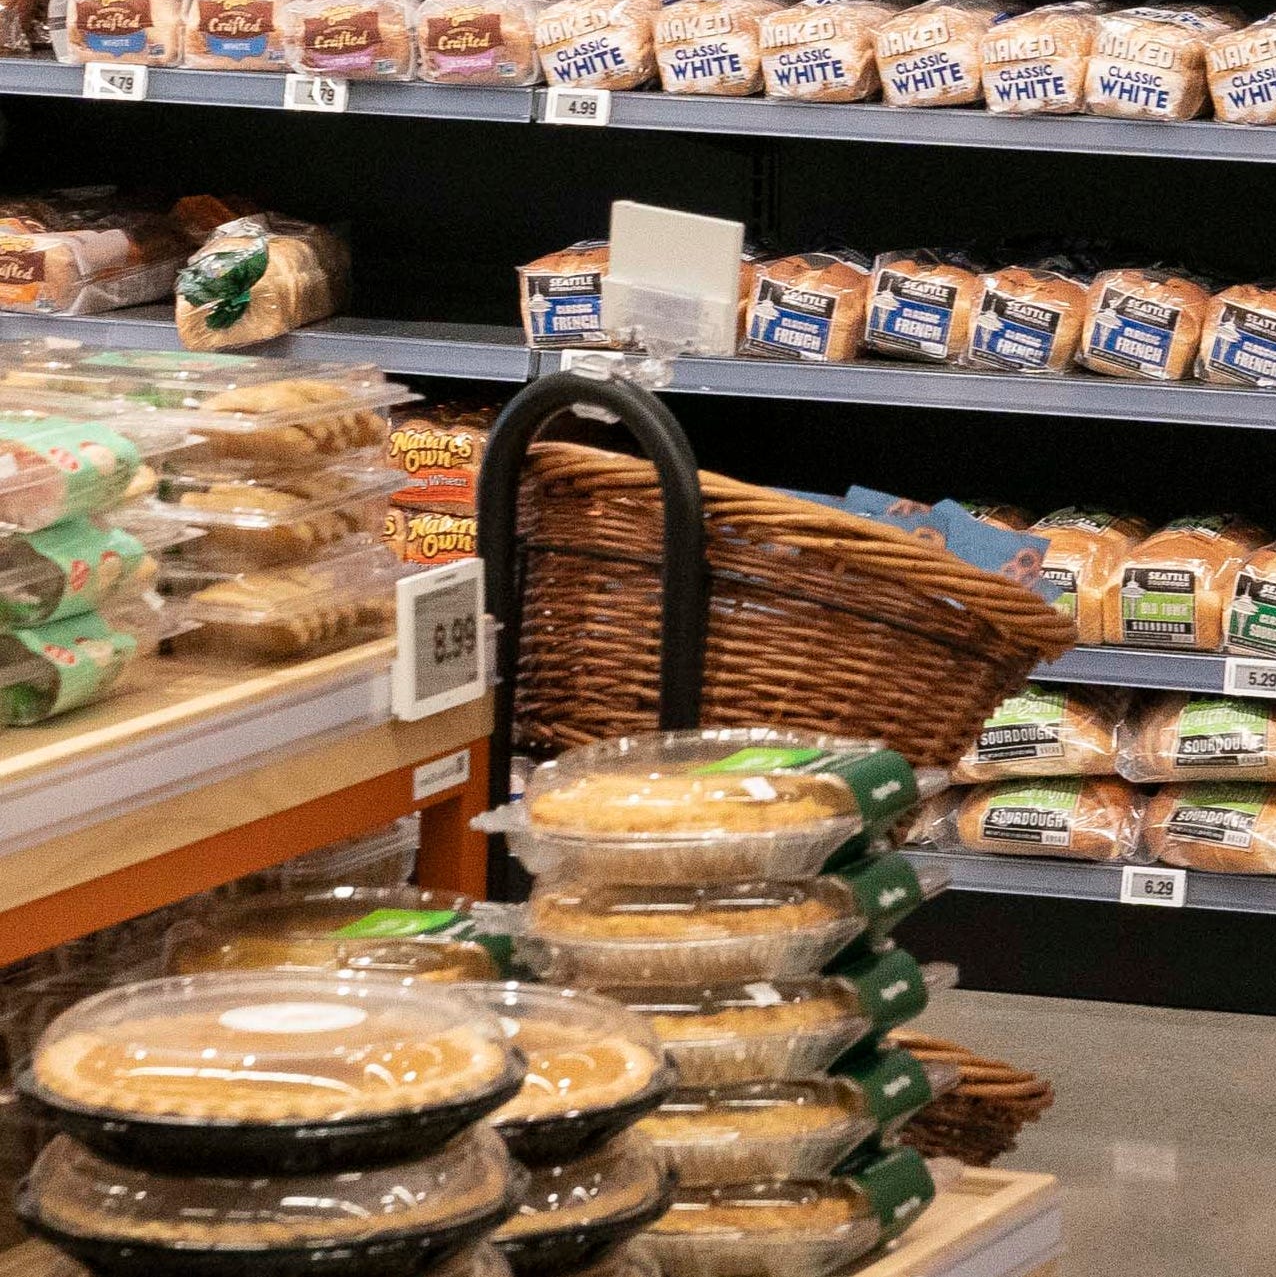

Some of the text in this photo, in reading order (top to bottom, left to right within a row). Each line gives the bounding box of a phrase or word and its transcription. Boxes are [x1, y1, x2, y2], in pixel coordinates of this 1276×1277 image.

[86, 14, 141, 32] Crafted
[209, 18, 262, 35] Crafted
[557, 37, 610, 64] CLASSIC
[675, 43, 728, 61] CLASSIC
[553, 47, 625, 82] WHITE
[671, 54, 742, 80] WHITE
[1000, 64, 1054, 81] CLASSIC
[995, 77, 1066, 99] WHITE
[568, 101, 597, 115] 4.99
[405, 450, 451, 473] Own
[1144, 878, 1174, 897] 6.29
